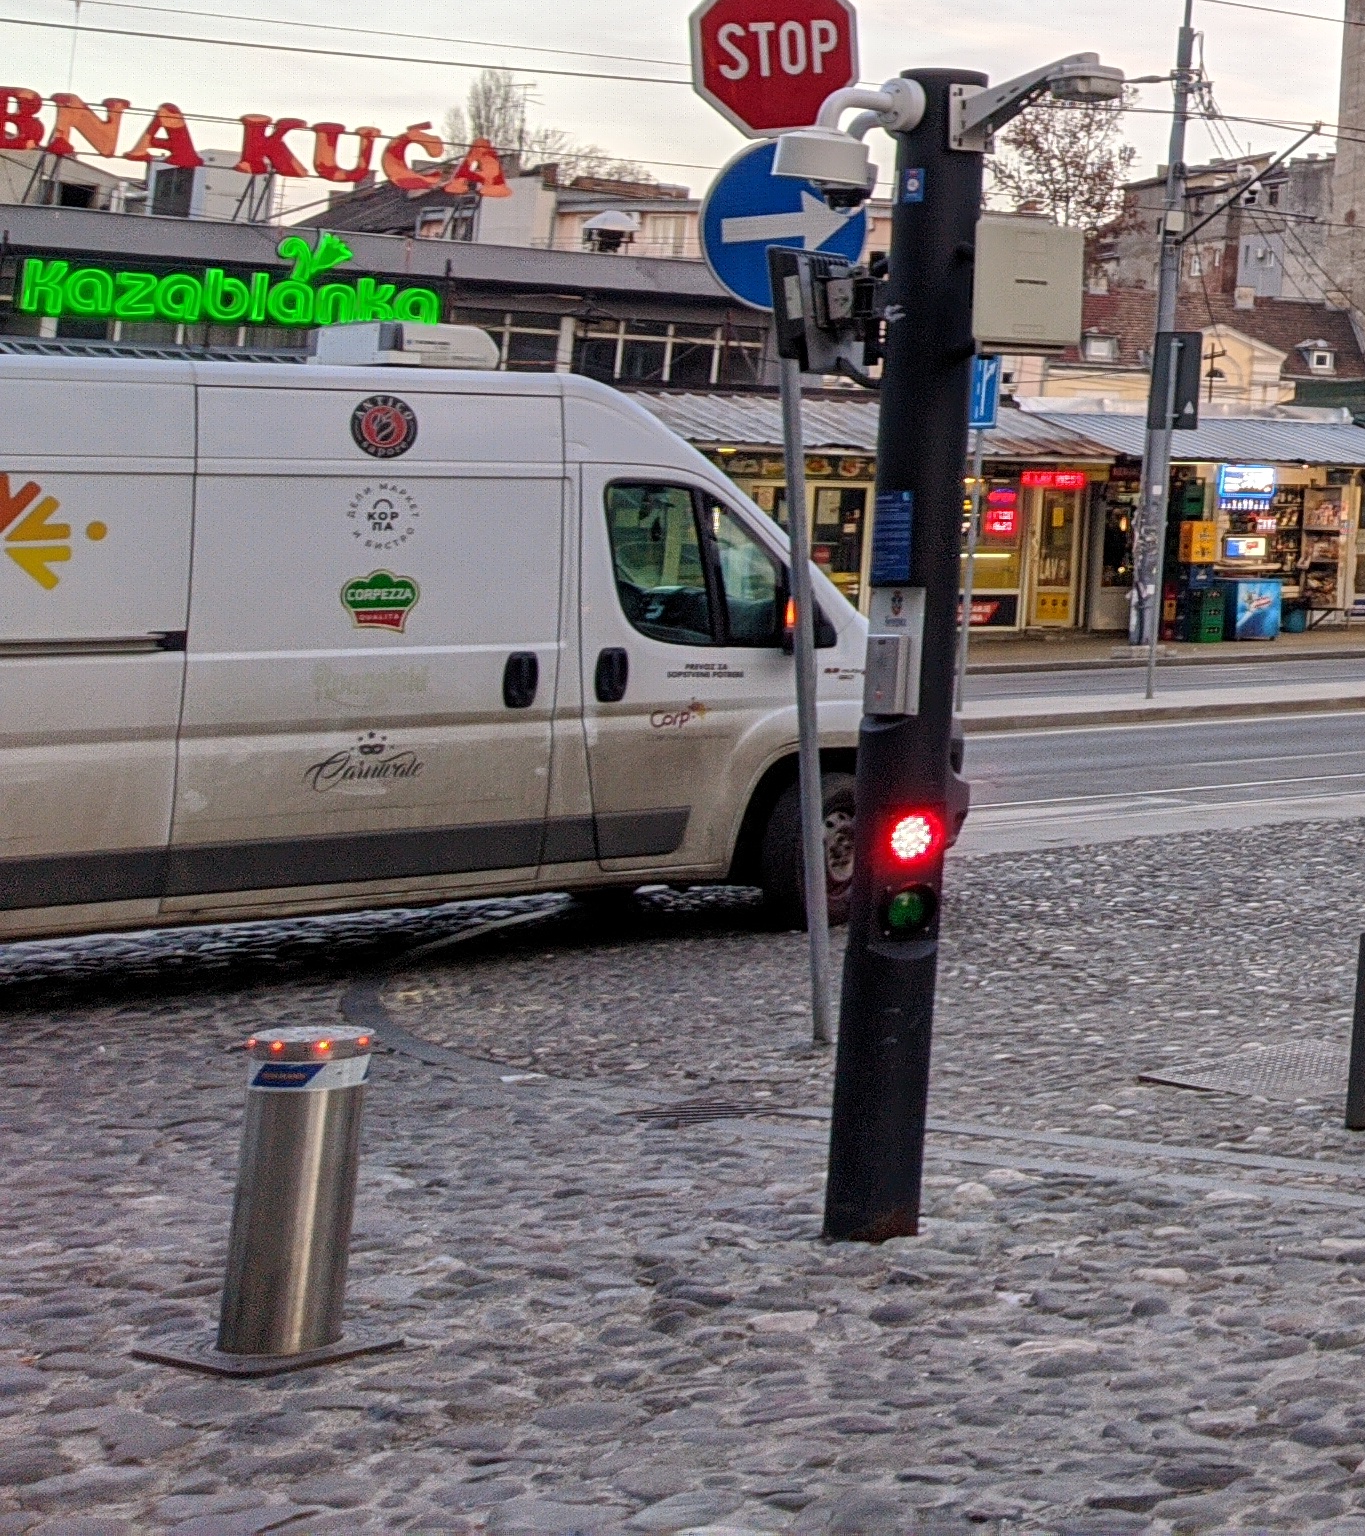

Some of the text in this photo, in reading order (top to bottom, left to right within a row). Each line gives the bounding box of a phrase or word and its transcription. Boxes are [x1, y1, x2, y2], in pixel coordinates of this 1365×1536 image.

[717, 20, 838, 80] STOP
[0, 87, 511, 198] BNA KUĆA
[20, 257, 442, 327] Kazablanka
[367, 511, 399, 521] КОР
[372, 522, 393, 532] ПА
[347, 588, 414, 601] CORPEZZA
[651, 710, 690, 729] Corp
